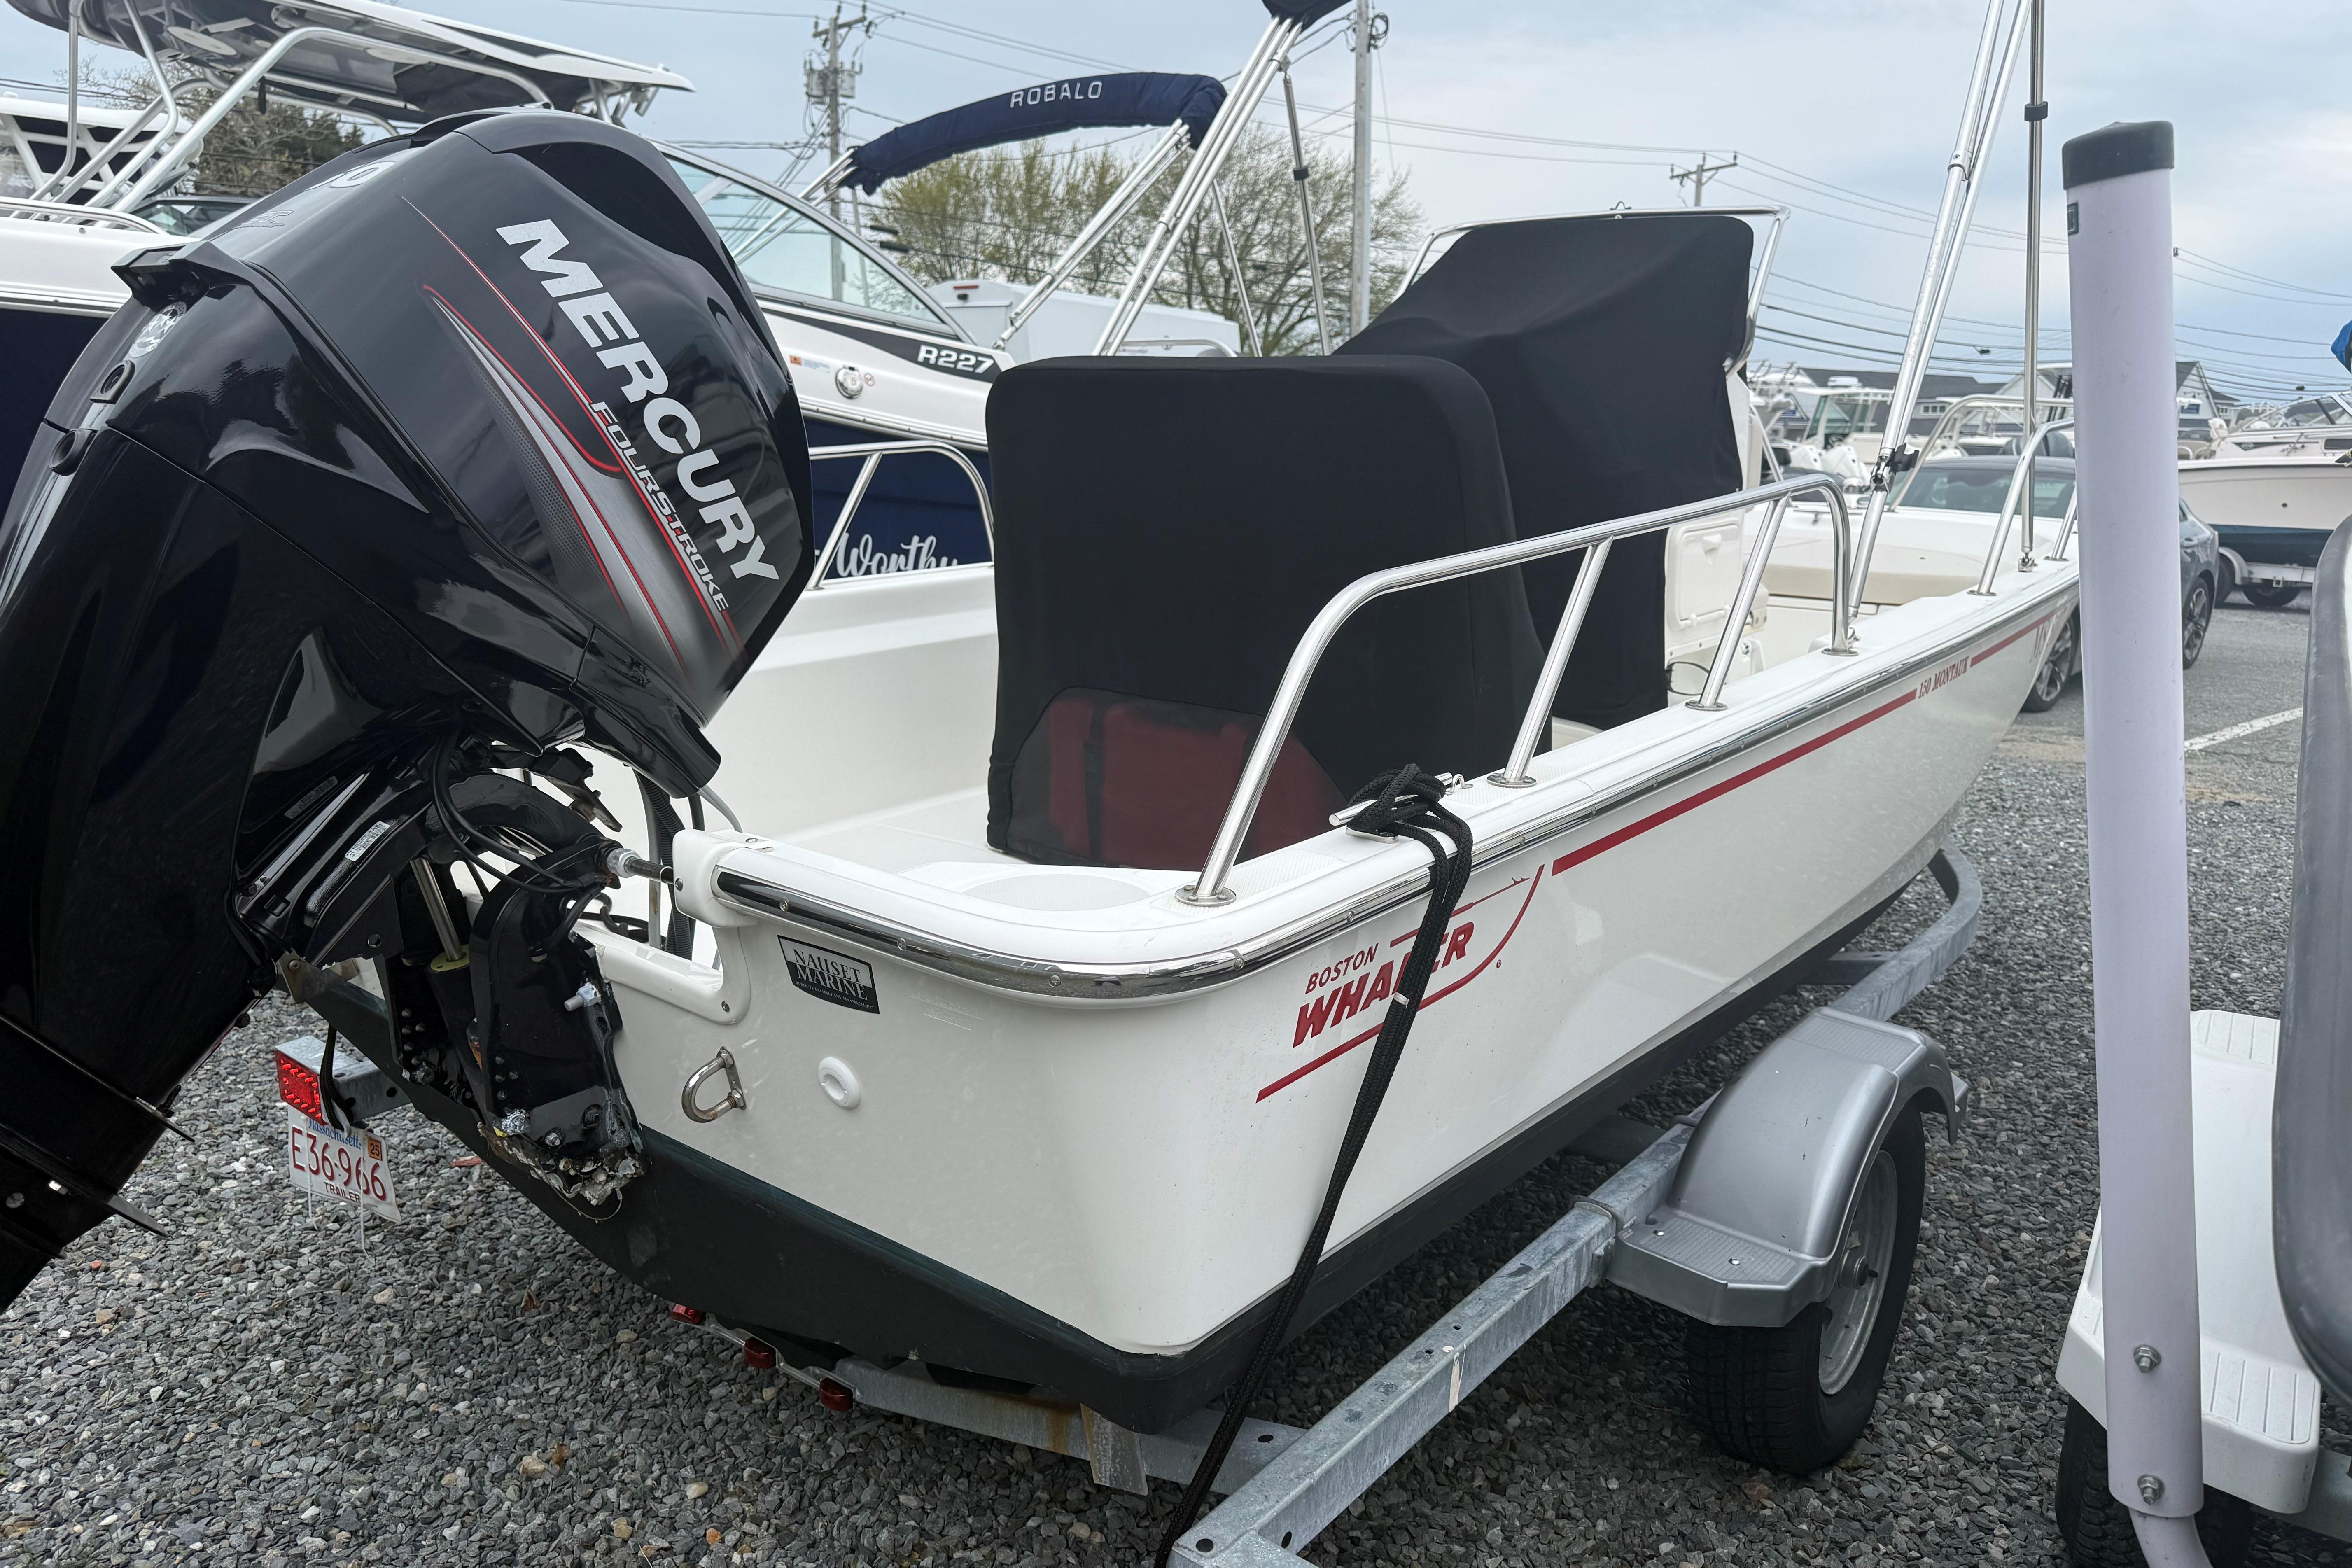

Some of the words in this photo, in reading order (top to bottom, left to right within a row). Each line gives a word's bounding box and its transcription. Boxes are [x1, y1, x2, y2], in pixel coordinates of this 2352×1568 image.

[1010, 81, 1103, 108] ROBALO
[917, 344, 995, 374] R227
[495, 218, 780, 580] MERCURY
[591, 401, 729, 611] FOURSTROKE
[1918, 677, 1932, 699] 150
[1932, 655, 1969, 691] MONTAUK
[793, 948, 860, 983] NAUSET
[795, 963, 868, 1001] MARINE
[1305, 943, 1379, 995] BOSTON
[370, 1143, 379, 1157] 25
[323, 1181, 361, 1204] TRAILER
